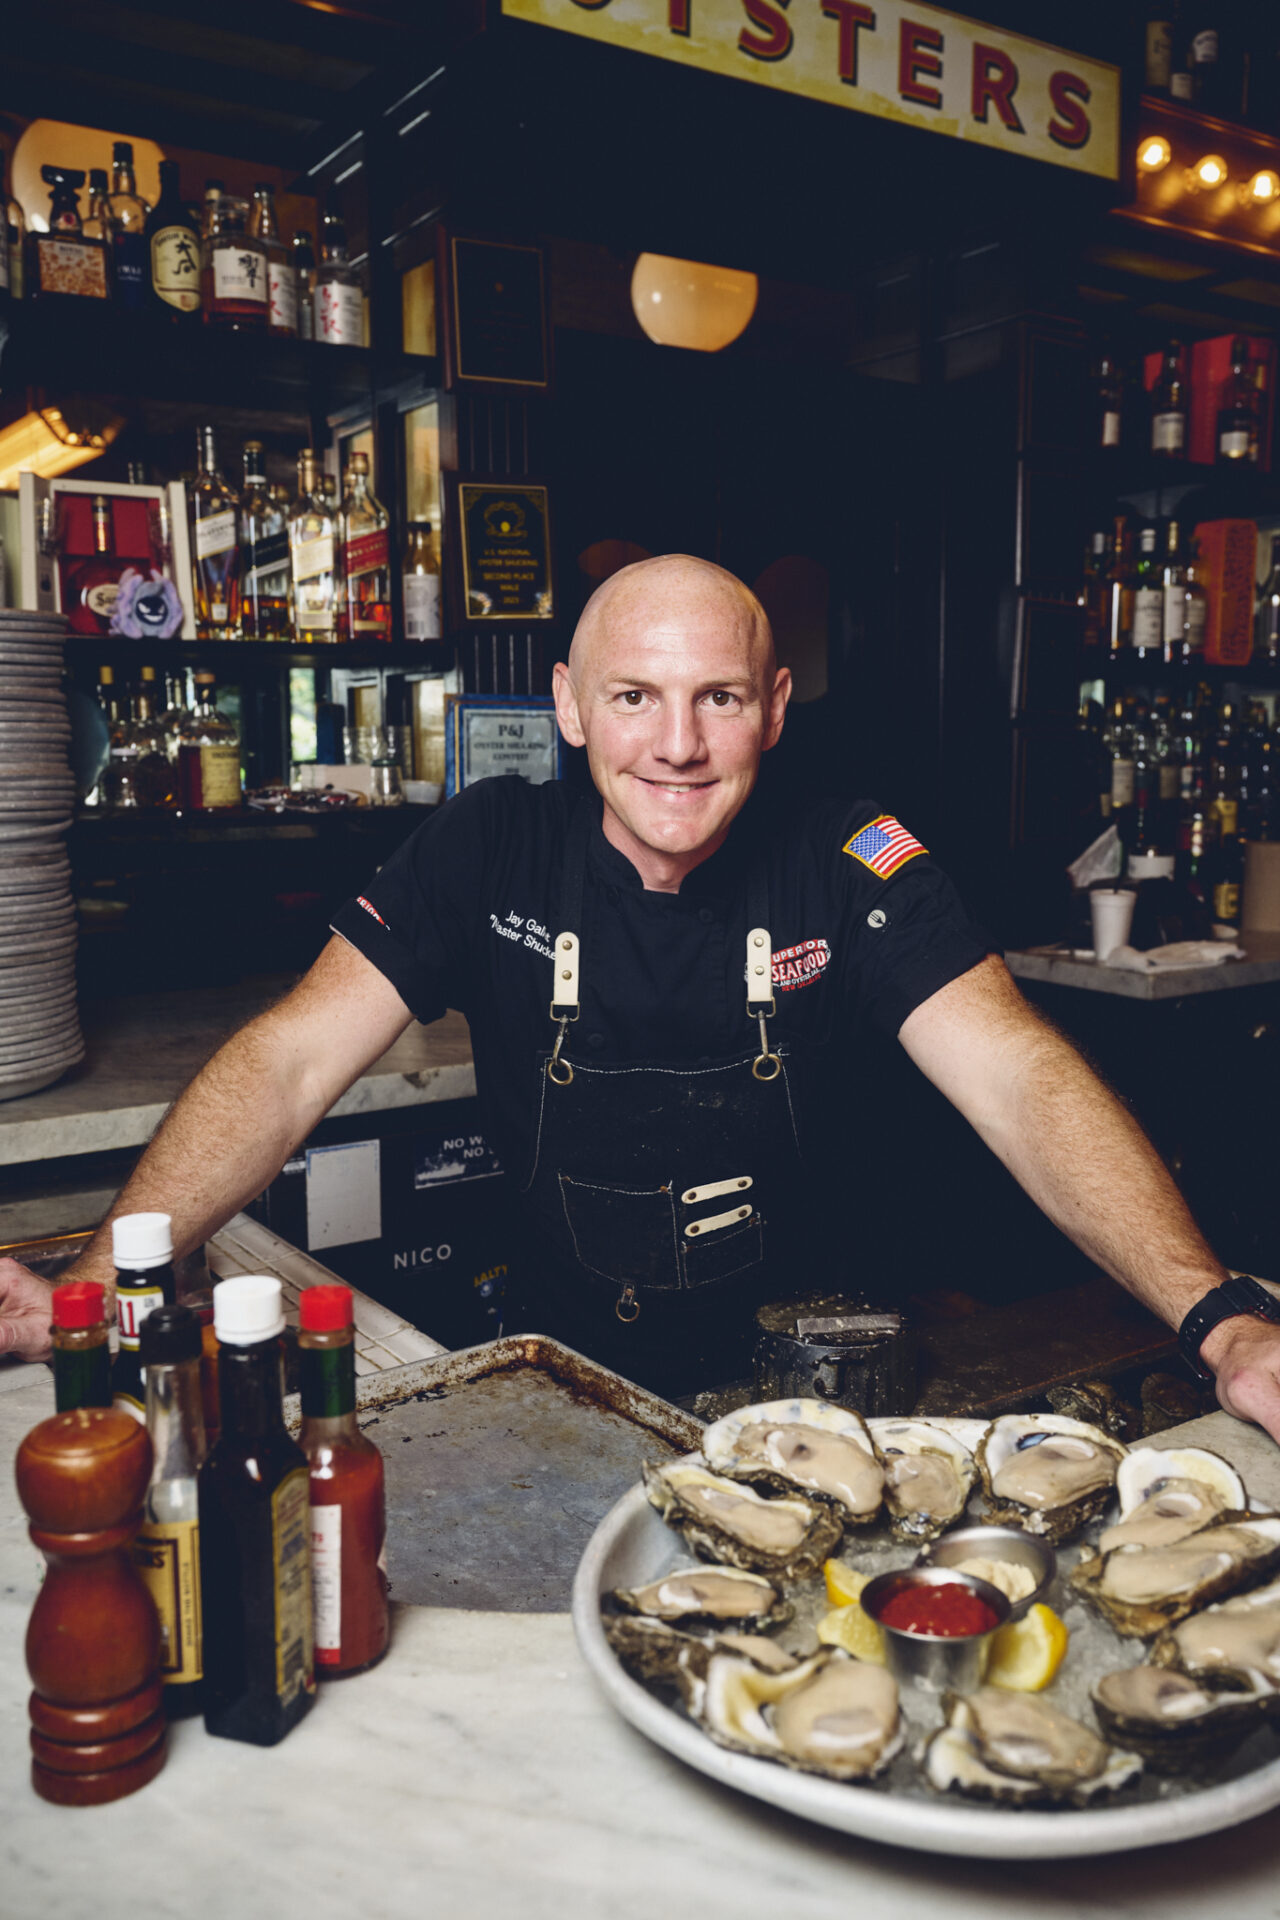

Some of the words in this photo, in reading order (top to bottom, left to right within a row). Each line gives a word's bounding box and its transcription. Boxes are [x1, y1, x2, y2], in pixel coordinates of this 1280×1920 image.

[570, 0, 1093, 151] STERS
[498, 724, 524, 738] P&J
[505, 910, 524, 928] Jay
[523, 934, 556, 960] Shucke
[772, 939, 827, 963] UPERIOR
[771, 951, 827, 982] SEAFOOD
[444, 1138, 464, 1150] NO
[464, 1147, 483, 1158] NO
[393, 1243, 452, 1270] NICO
